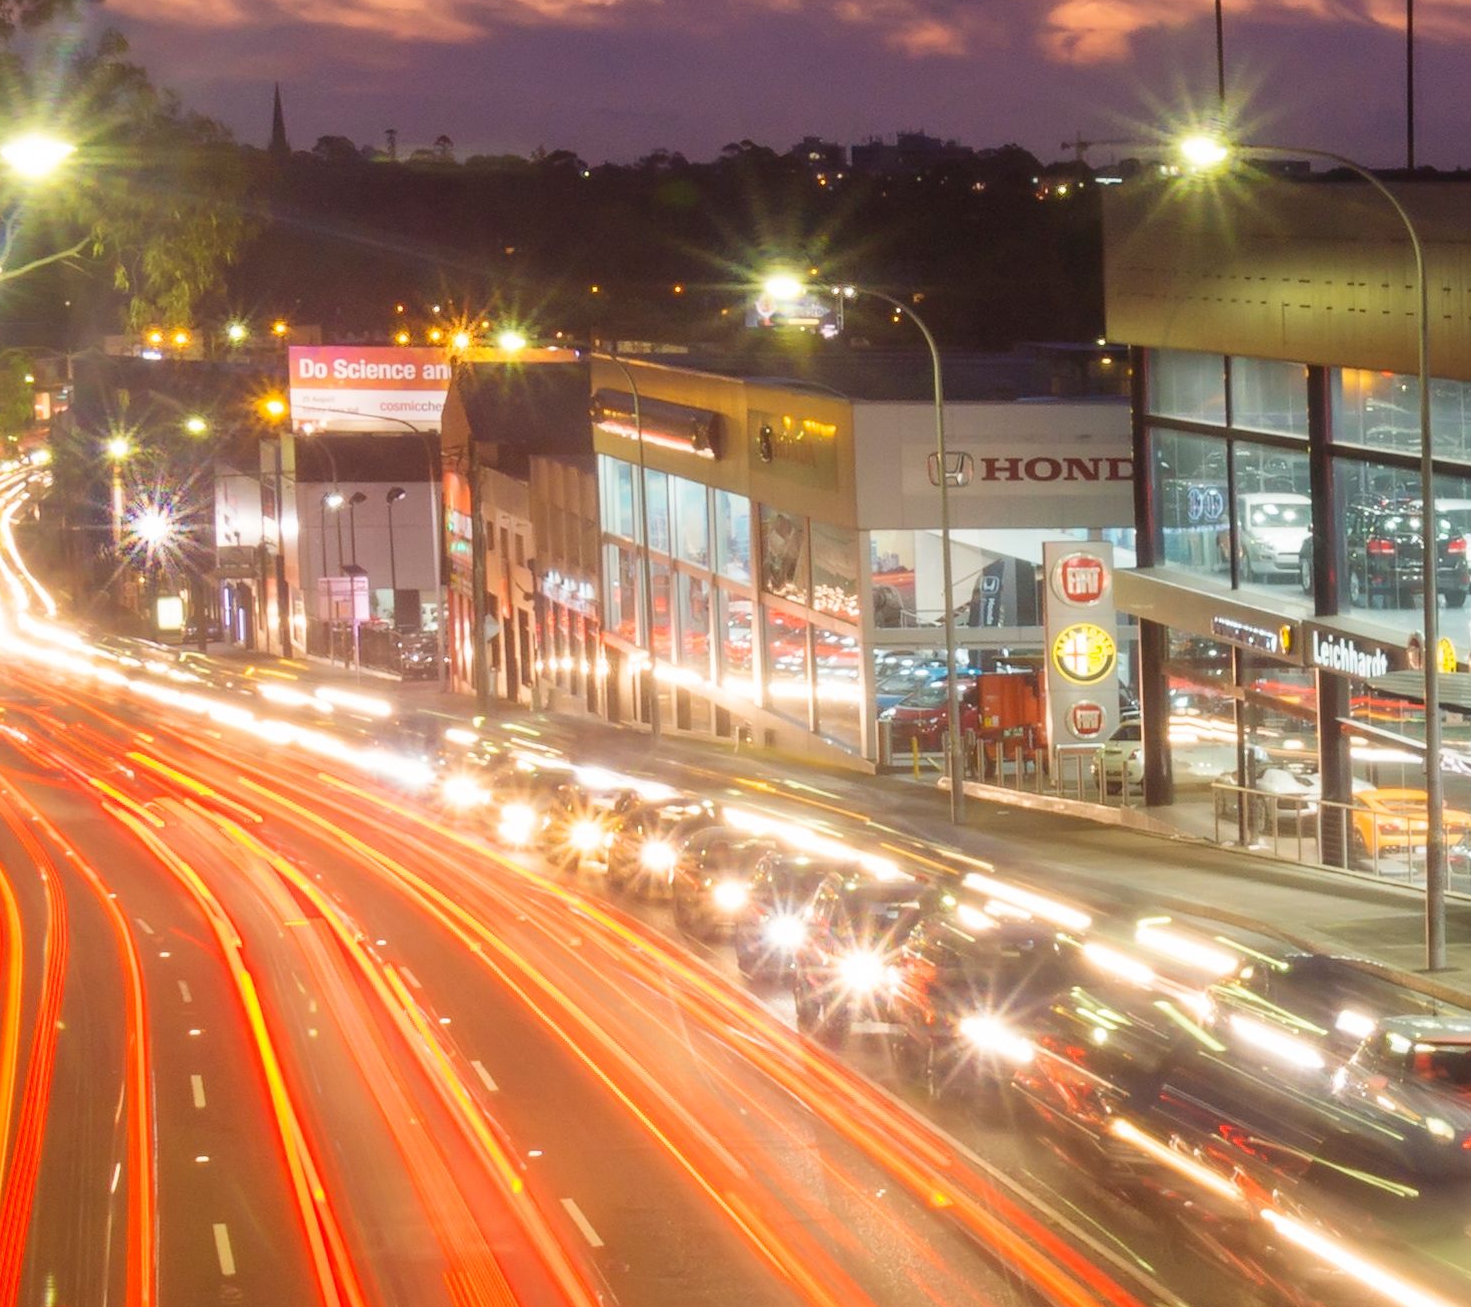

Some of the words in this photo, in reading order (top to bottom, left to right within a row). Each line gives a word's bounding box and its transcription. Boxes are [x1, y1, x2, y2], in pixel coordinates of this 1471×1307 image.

[299, 358, 327, 379] Do
[333, 359, 416, 380] Science
[1066, 567, 1101, 594] FIAT
[1313, 630, 1388, 678] Leichhardt
[1076, 710, 1100, 729] FIAT
